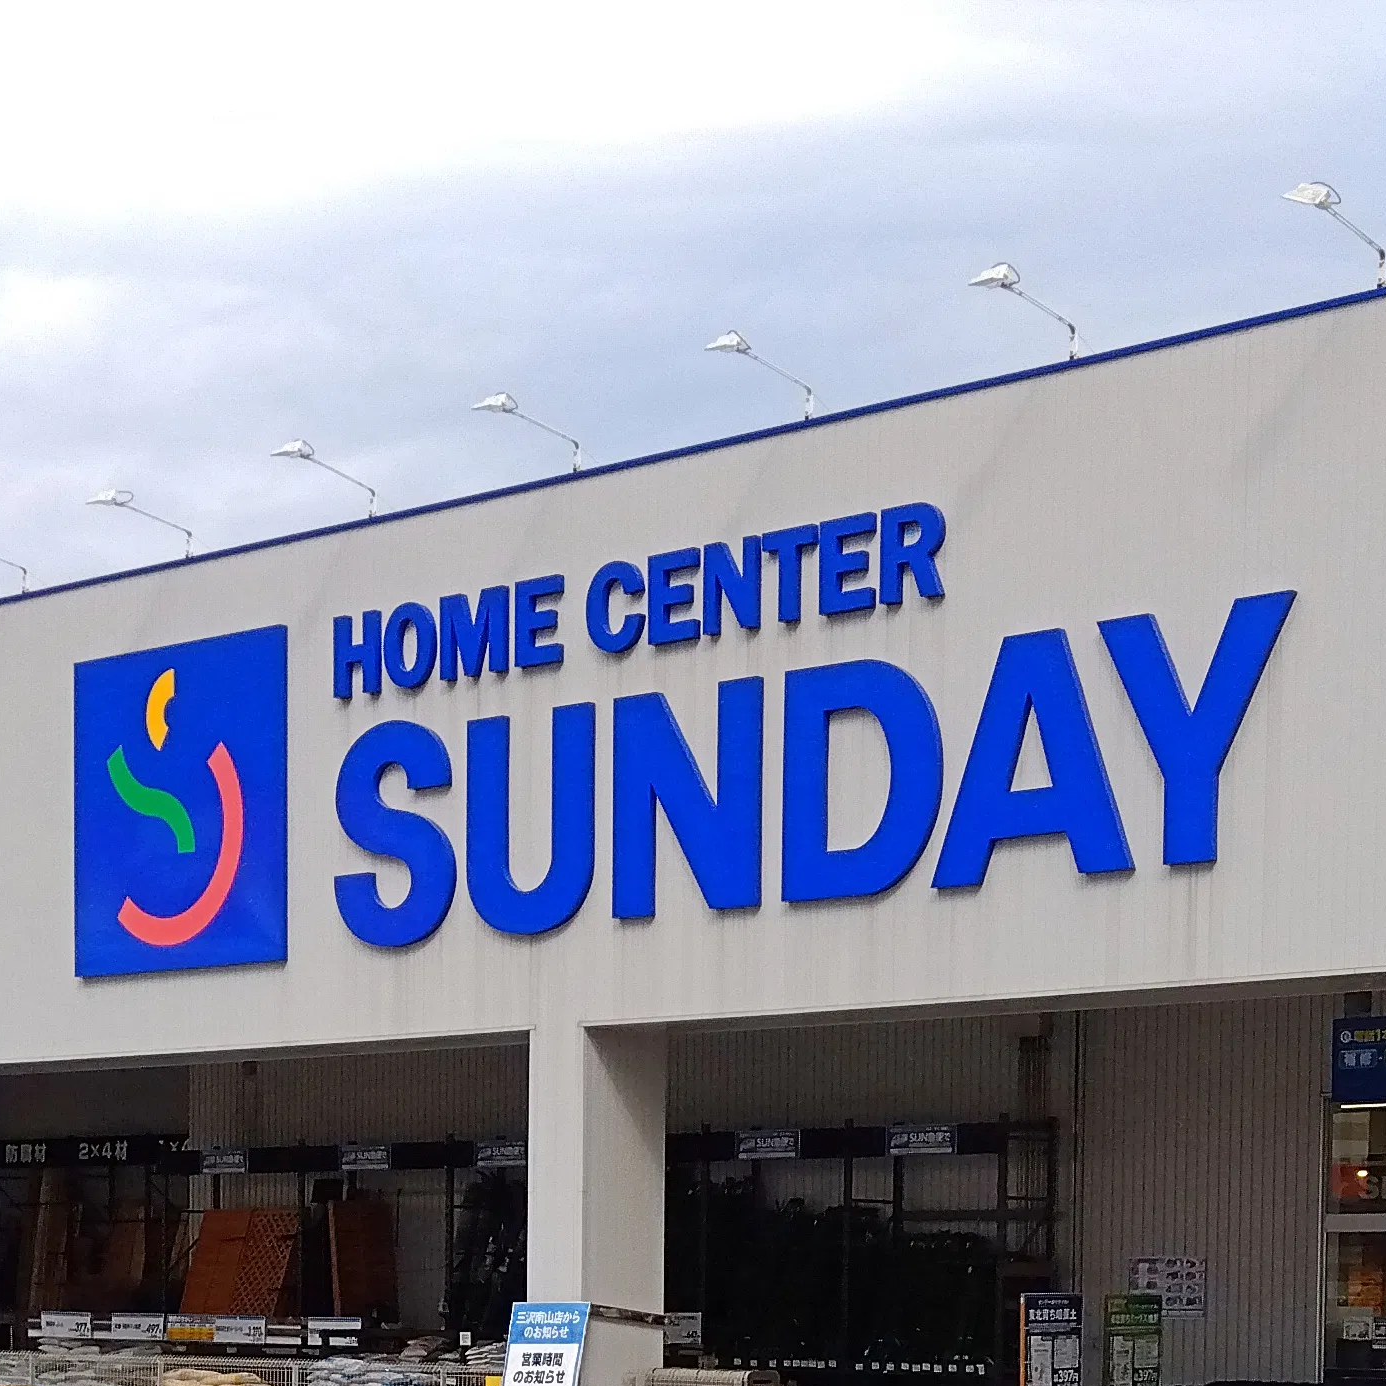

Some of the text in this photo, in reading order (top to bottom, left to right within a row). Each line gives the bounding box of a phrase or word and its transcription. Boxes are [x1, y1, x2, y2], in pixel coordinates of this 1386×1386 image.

[332, 501, 946, 702] HOME CENTER
[333, 590, 1297, 948] SUNDAY
[524, 1325, 569, 1338] のお知らせ
[521, 1352, 564, 1367] 営業時間
[512, 1369, 565, 1384] のお知らせ
